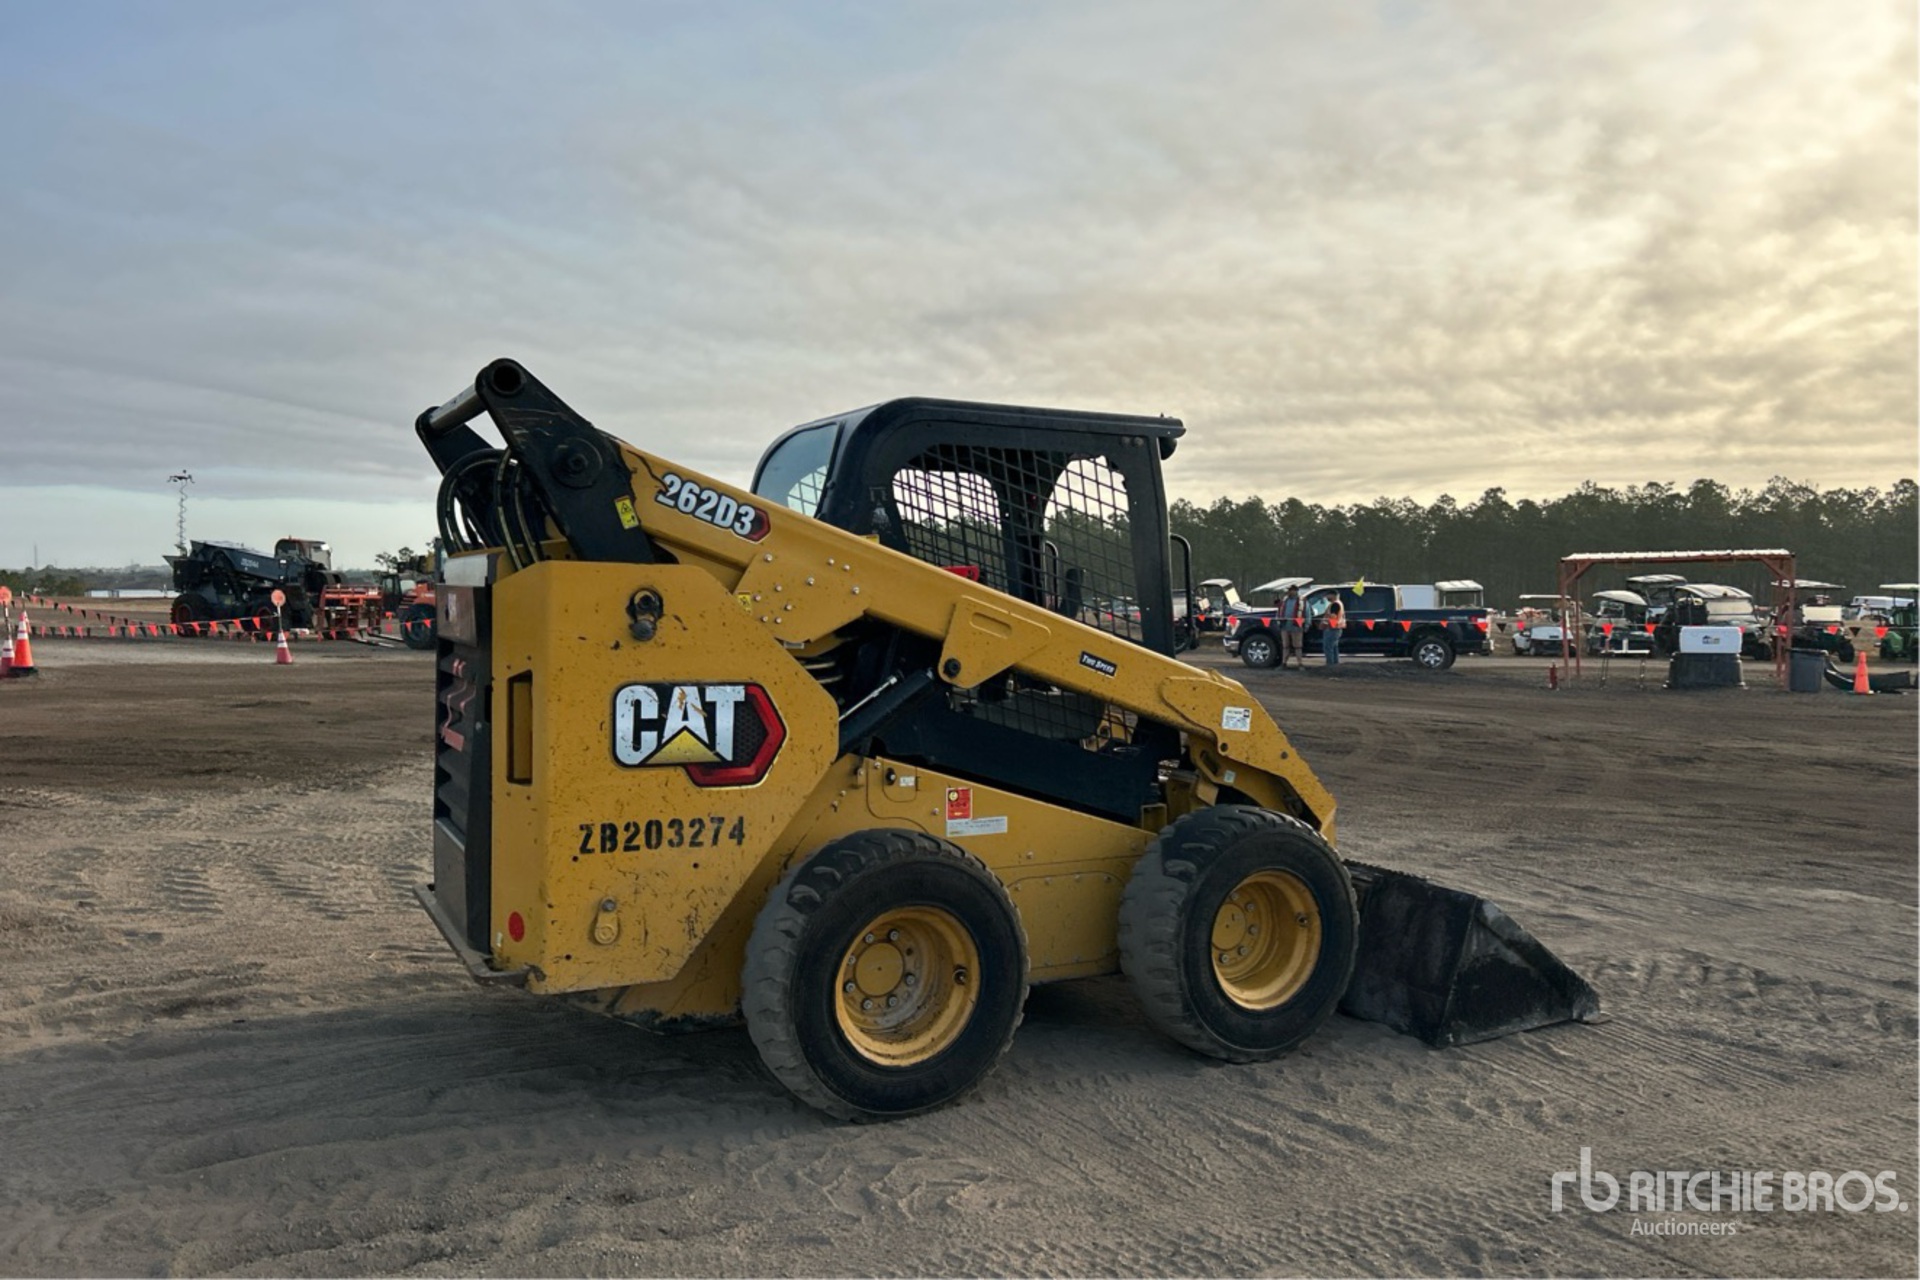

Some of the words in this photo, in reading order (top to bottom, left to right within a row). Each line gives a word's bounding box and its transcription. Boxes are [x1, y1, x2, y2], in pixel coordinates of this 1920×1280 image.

[657, 473, 756, 535] 262D3
[615, 685, 745, 765] CAT
[579, 816, 745, 854] ZB203274
